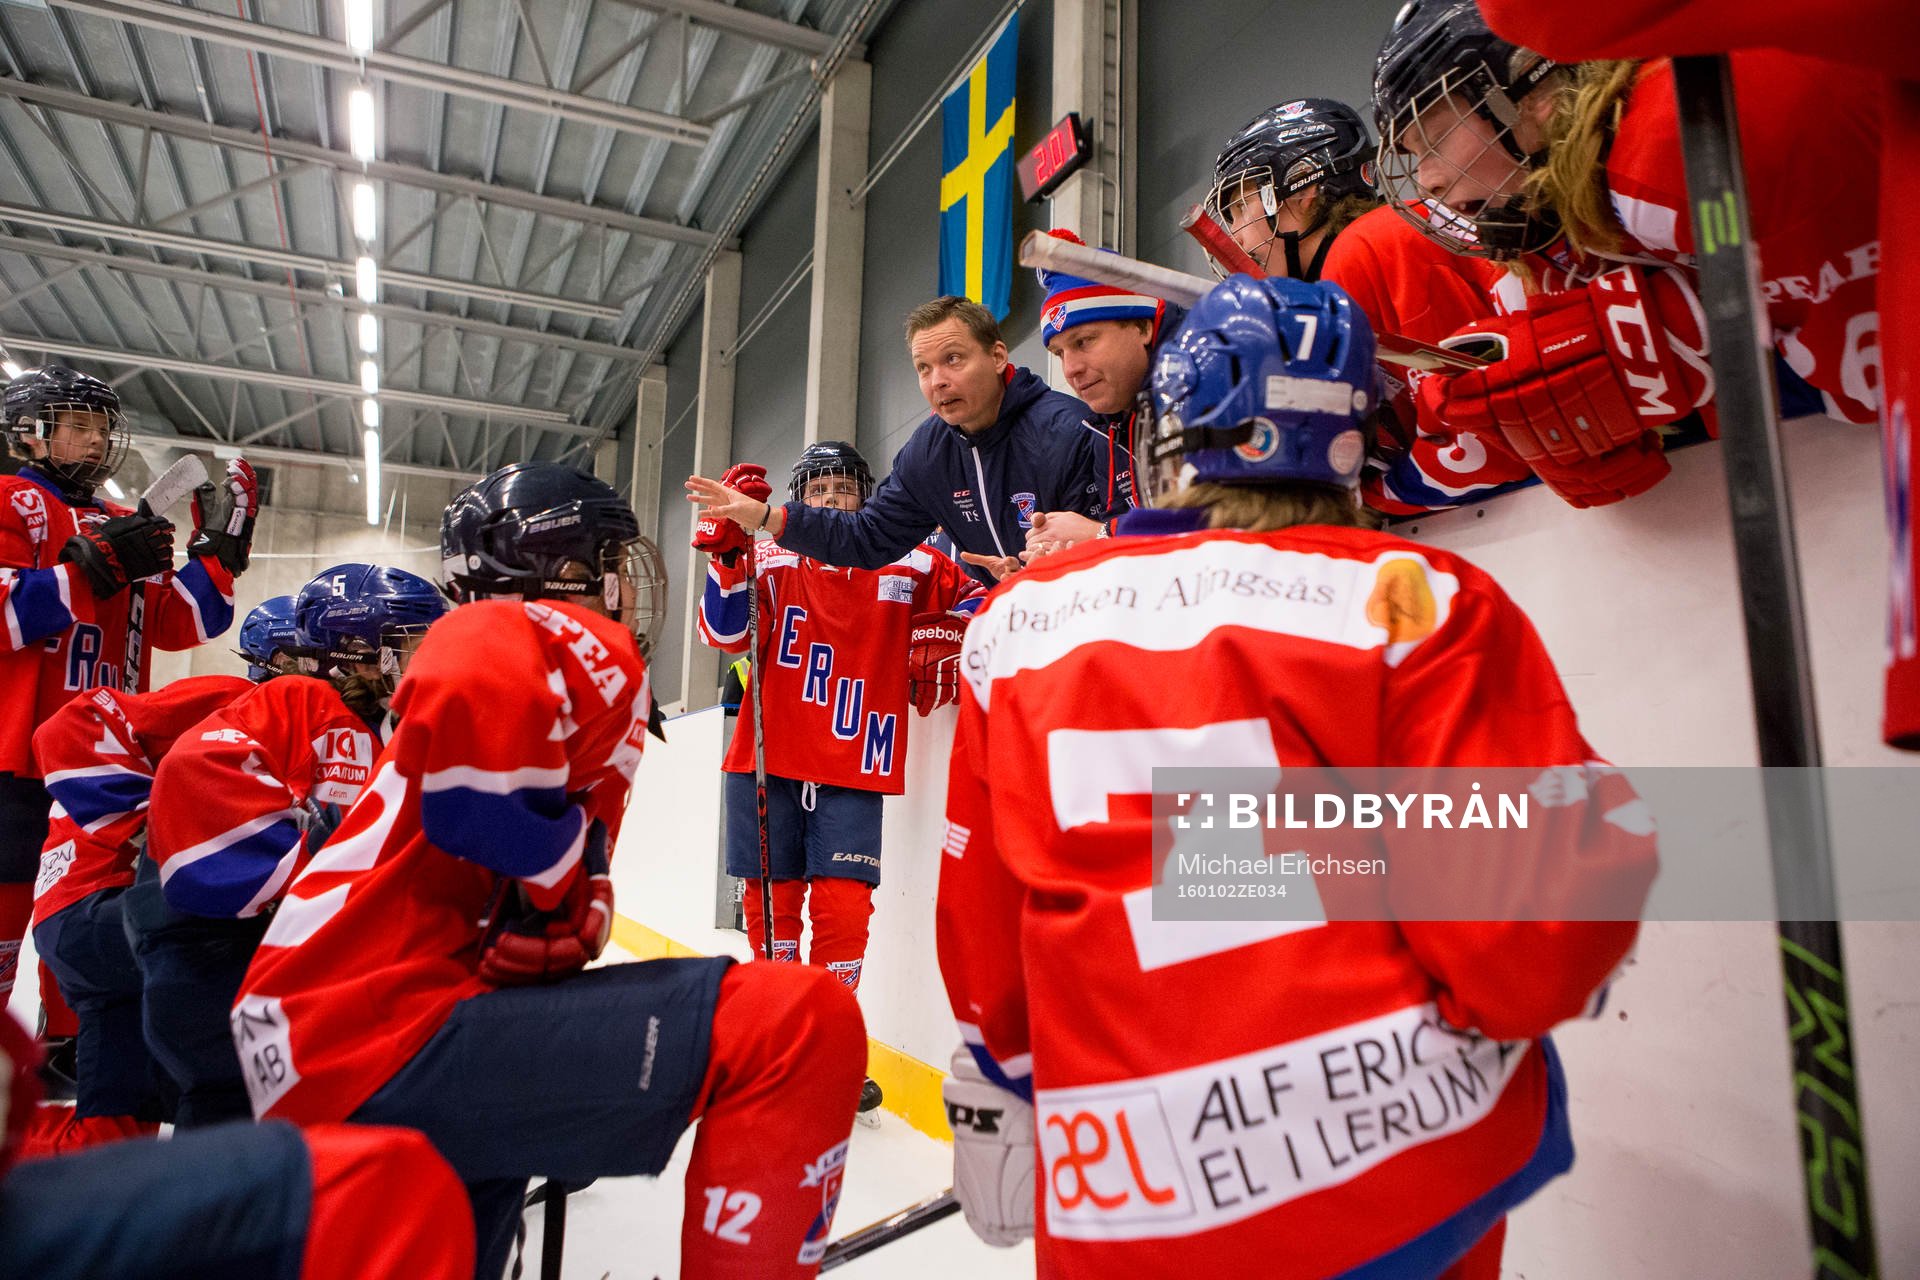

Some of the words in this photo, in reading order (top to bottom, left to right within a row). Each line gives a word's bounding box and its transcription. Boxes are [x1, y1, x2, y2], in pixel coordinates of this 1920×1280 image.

[1290, 170, 1325, 192] BAUER
[1294, 314, 1318, 360] 7
[528, 514, 582, 535] BAUER
[332, 574, 347, 597] 5
[545, 581, 587, 591] BAUER
[911, 626, 964, 643] Reebok
[330, 651, 364, 661] BAUER
[539, 609, 628, 708] PEA
[758, 824, 769, 877] VAPOR
[774, 941, 796, 949] ERUM
[1191, 1062, 1296, 1143] ALF
[1196, 1149, 1269, 1211] EL
[1284, 1132, 1301, 1181] I
[1315, 1048, 1490, 1168] LERUM
[703, 1185, 763, 1247] 12
